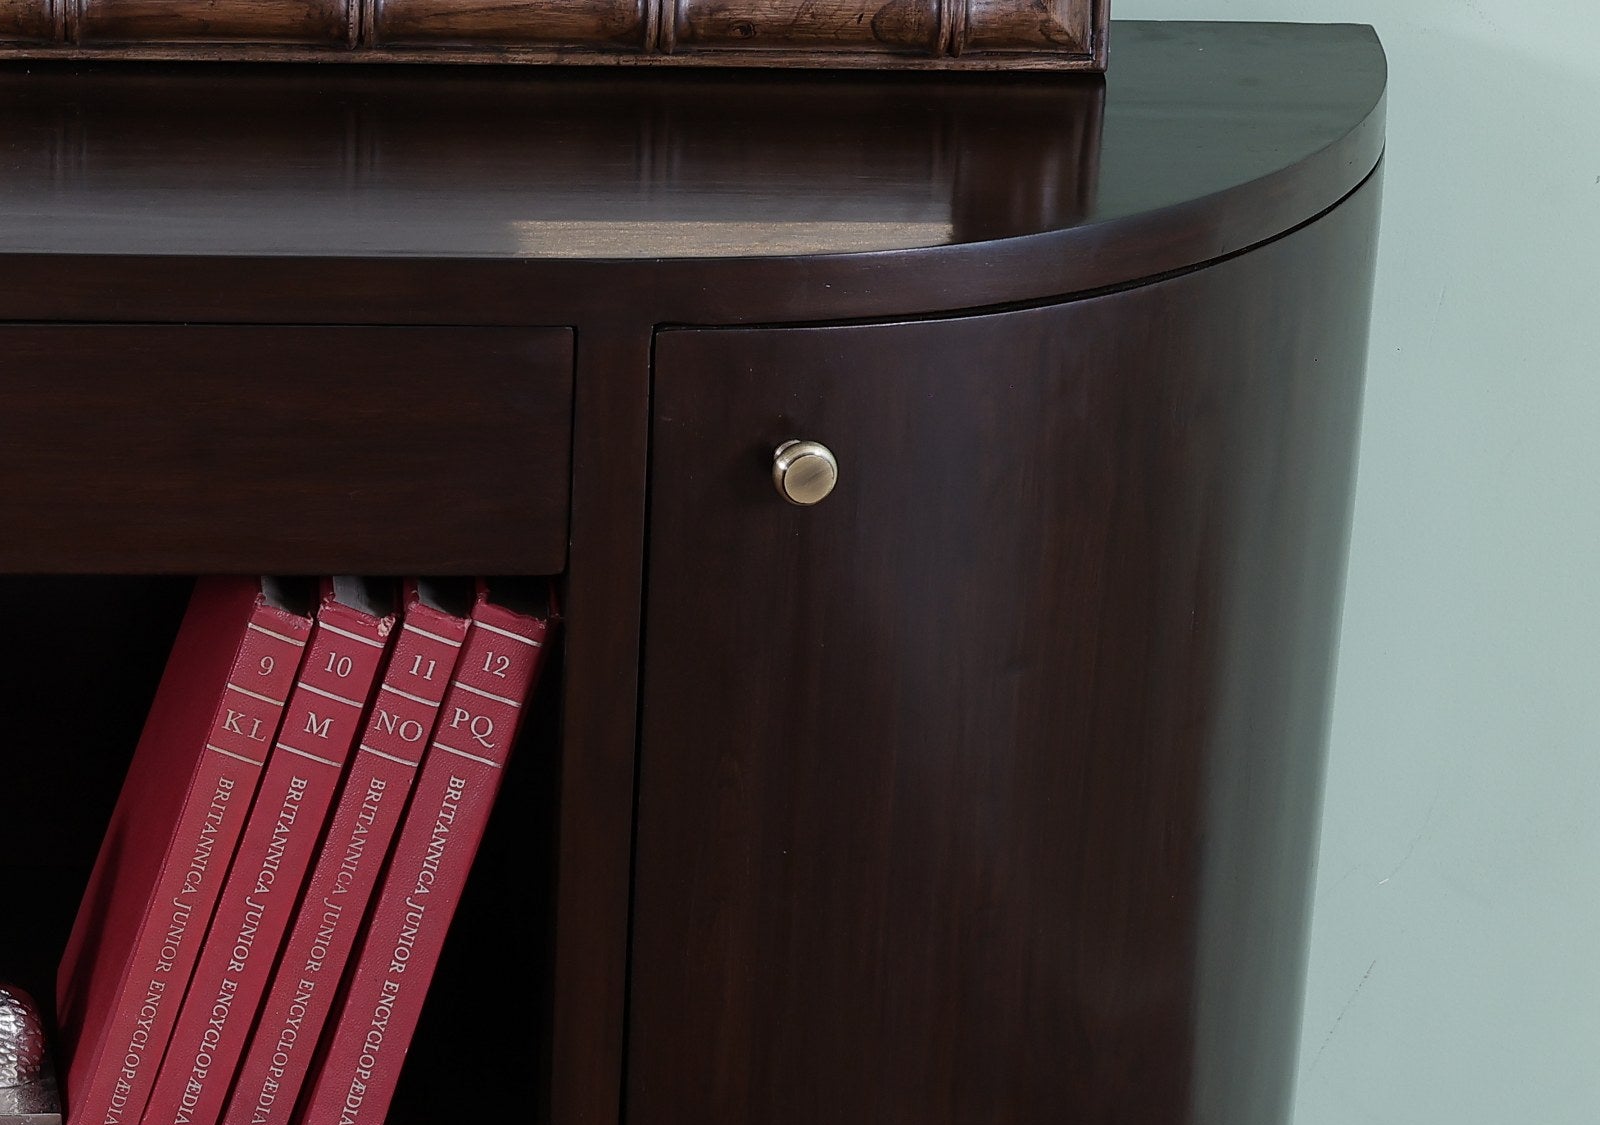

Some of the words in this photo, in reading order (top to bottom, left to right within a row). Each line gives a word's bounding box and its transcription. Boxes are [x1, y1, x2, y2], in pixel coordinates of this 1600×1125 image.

[258, 655, 275, 676] 9
[326, 652, 353, 678] 10
[409, 655, 437, 680] 11
[481, 651, 510, 679] 12
[304, 713, 334, 739] M
[374, 710, 423, 743] NO
[450, 708, 495, 748] PQ
[181, 776, 234, 895] BRITANNICA
[254, 776, 307, 895] BRITANNICA
[332, 776, 386, 895] BRITANNICA
[415, 776, 466, 895] BRITANNICA
[156, 897, 192, 973] JUNIOR
[226, 896, 266, 972] JUNIOR
[307, 897, 342, 972] JUNIOR
[389, 896, 426, 974] JUNIOR
[104, 979, 167, 1125] ENCYCLOPÆDIA
[174, 979, 237, 1125] ENCYCLOPÆDIA
[251, 979, 314, 1125] ENCYCLOPÆDIA
